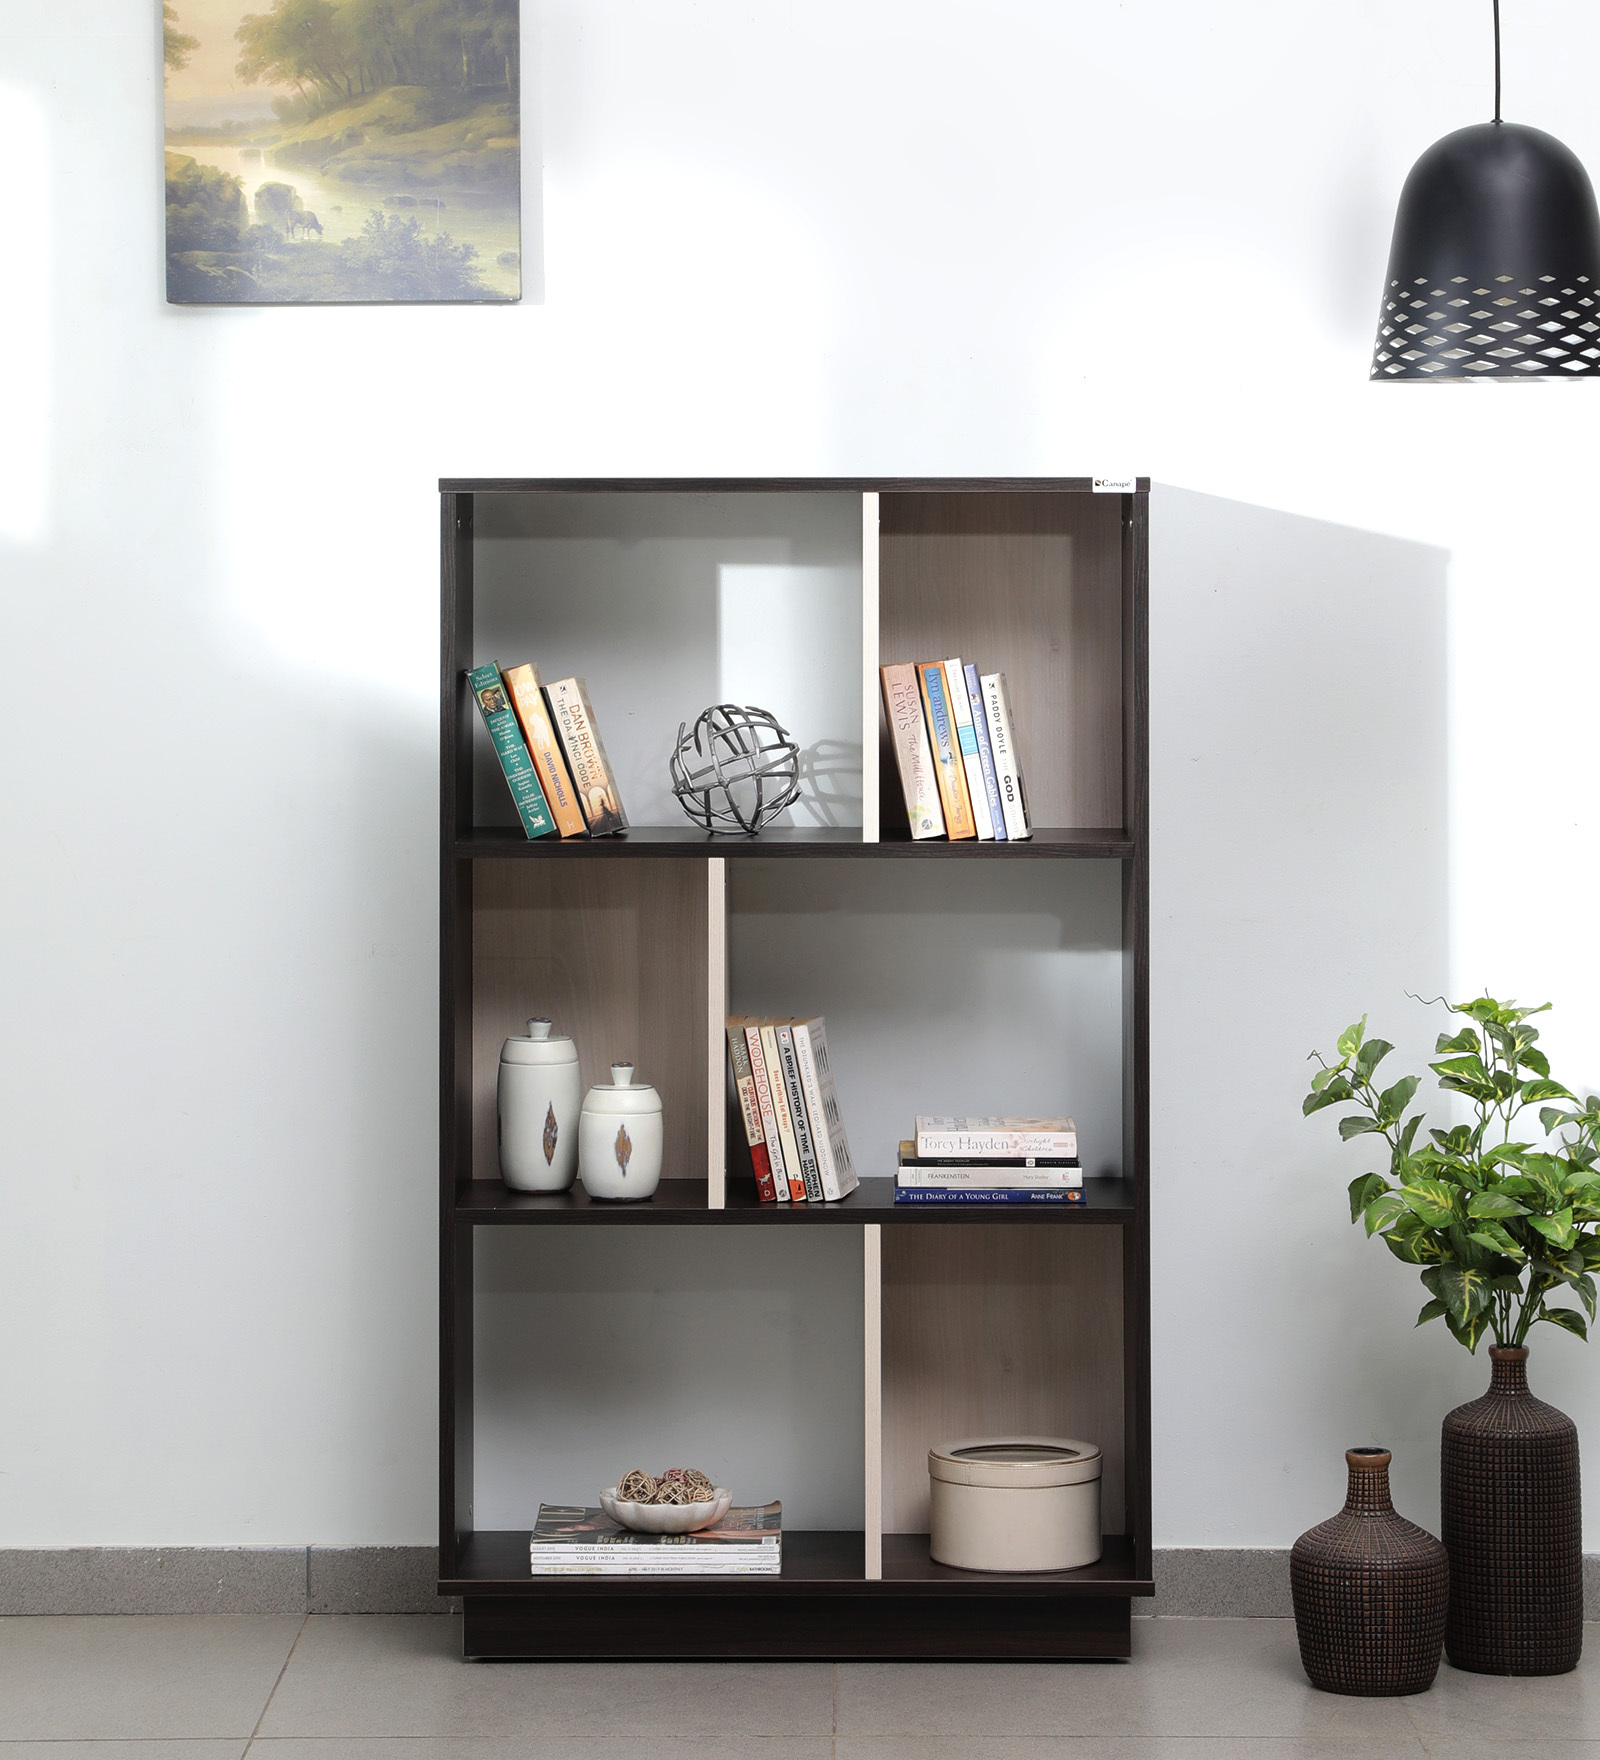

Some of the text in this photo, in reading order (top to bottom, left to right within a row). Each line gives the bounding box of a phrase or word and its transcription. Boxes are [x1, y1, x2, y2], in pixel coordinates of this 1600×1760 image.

[474, 677, 498, 688] Editions
[476, 672, 492, 680] Select
[520, 693, 538, 707] DAY
[557, 698, 568, 716] THE
[892, 682, 910, 731] LEWIS
[904, 684, 920, 724] SUSAN
[991, 695, 1002, 722] PADDY
[562, 718, 572, 732] DA
[932, 696, 950, 748] andrews
[973, 710, 984, 733] Anne
[569, 704, 602, 781] DAN BROWN
[908, 734, 918, 752] The
[979, 734, 988, 746] of
[996, 726, 1006, 754] DOYLE
[980, 747, 991, 774] Green
[544, 752, 568, 808] DAVID NICHOLLS
[577, 762, 592, 788] CODE
[986, 776, 998, 806] Gables
[1004, 775, 1014, 802] GOD
[732, 1038, 744, 1073] HADDON
[740, 1043, 748, 1066] MARK
[785, 1054, 796, 1080] BRIEF
[748, 1032, 773, 1117] WODEHOUSE
[790, 1081, 802, 1118] HISTORY
[809, 1090, 817, 1106] WALK
[798, 1120, 806, 1131] OF
[800, 1132, 810, 1154] TIME
[958, 1136, 1008, 1154] Hayden
[802, 1160, 814, 1199] HAWKING
[808, 1158, 820, 1198] STEPHEN
